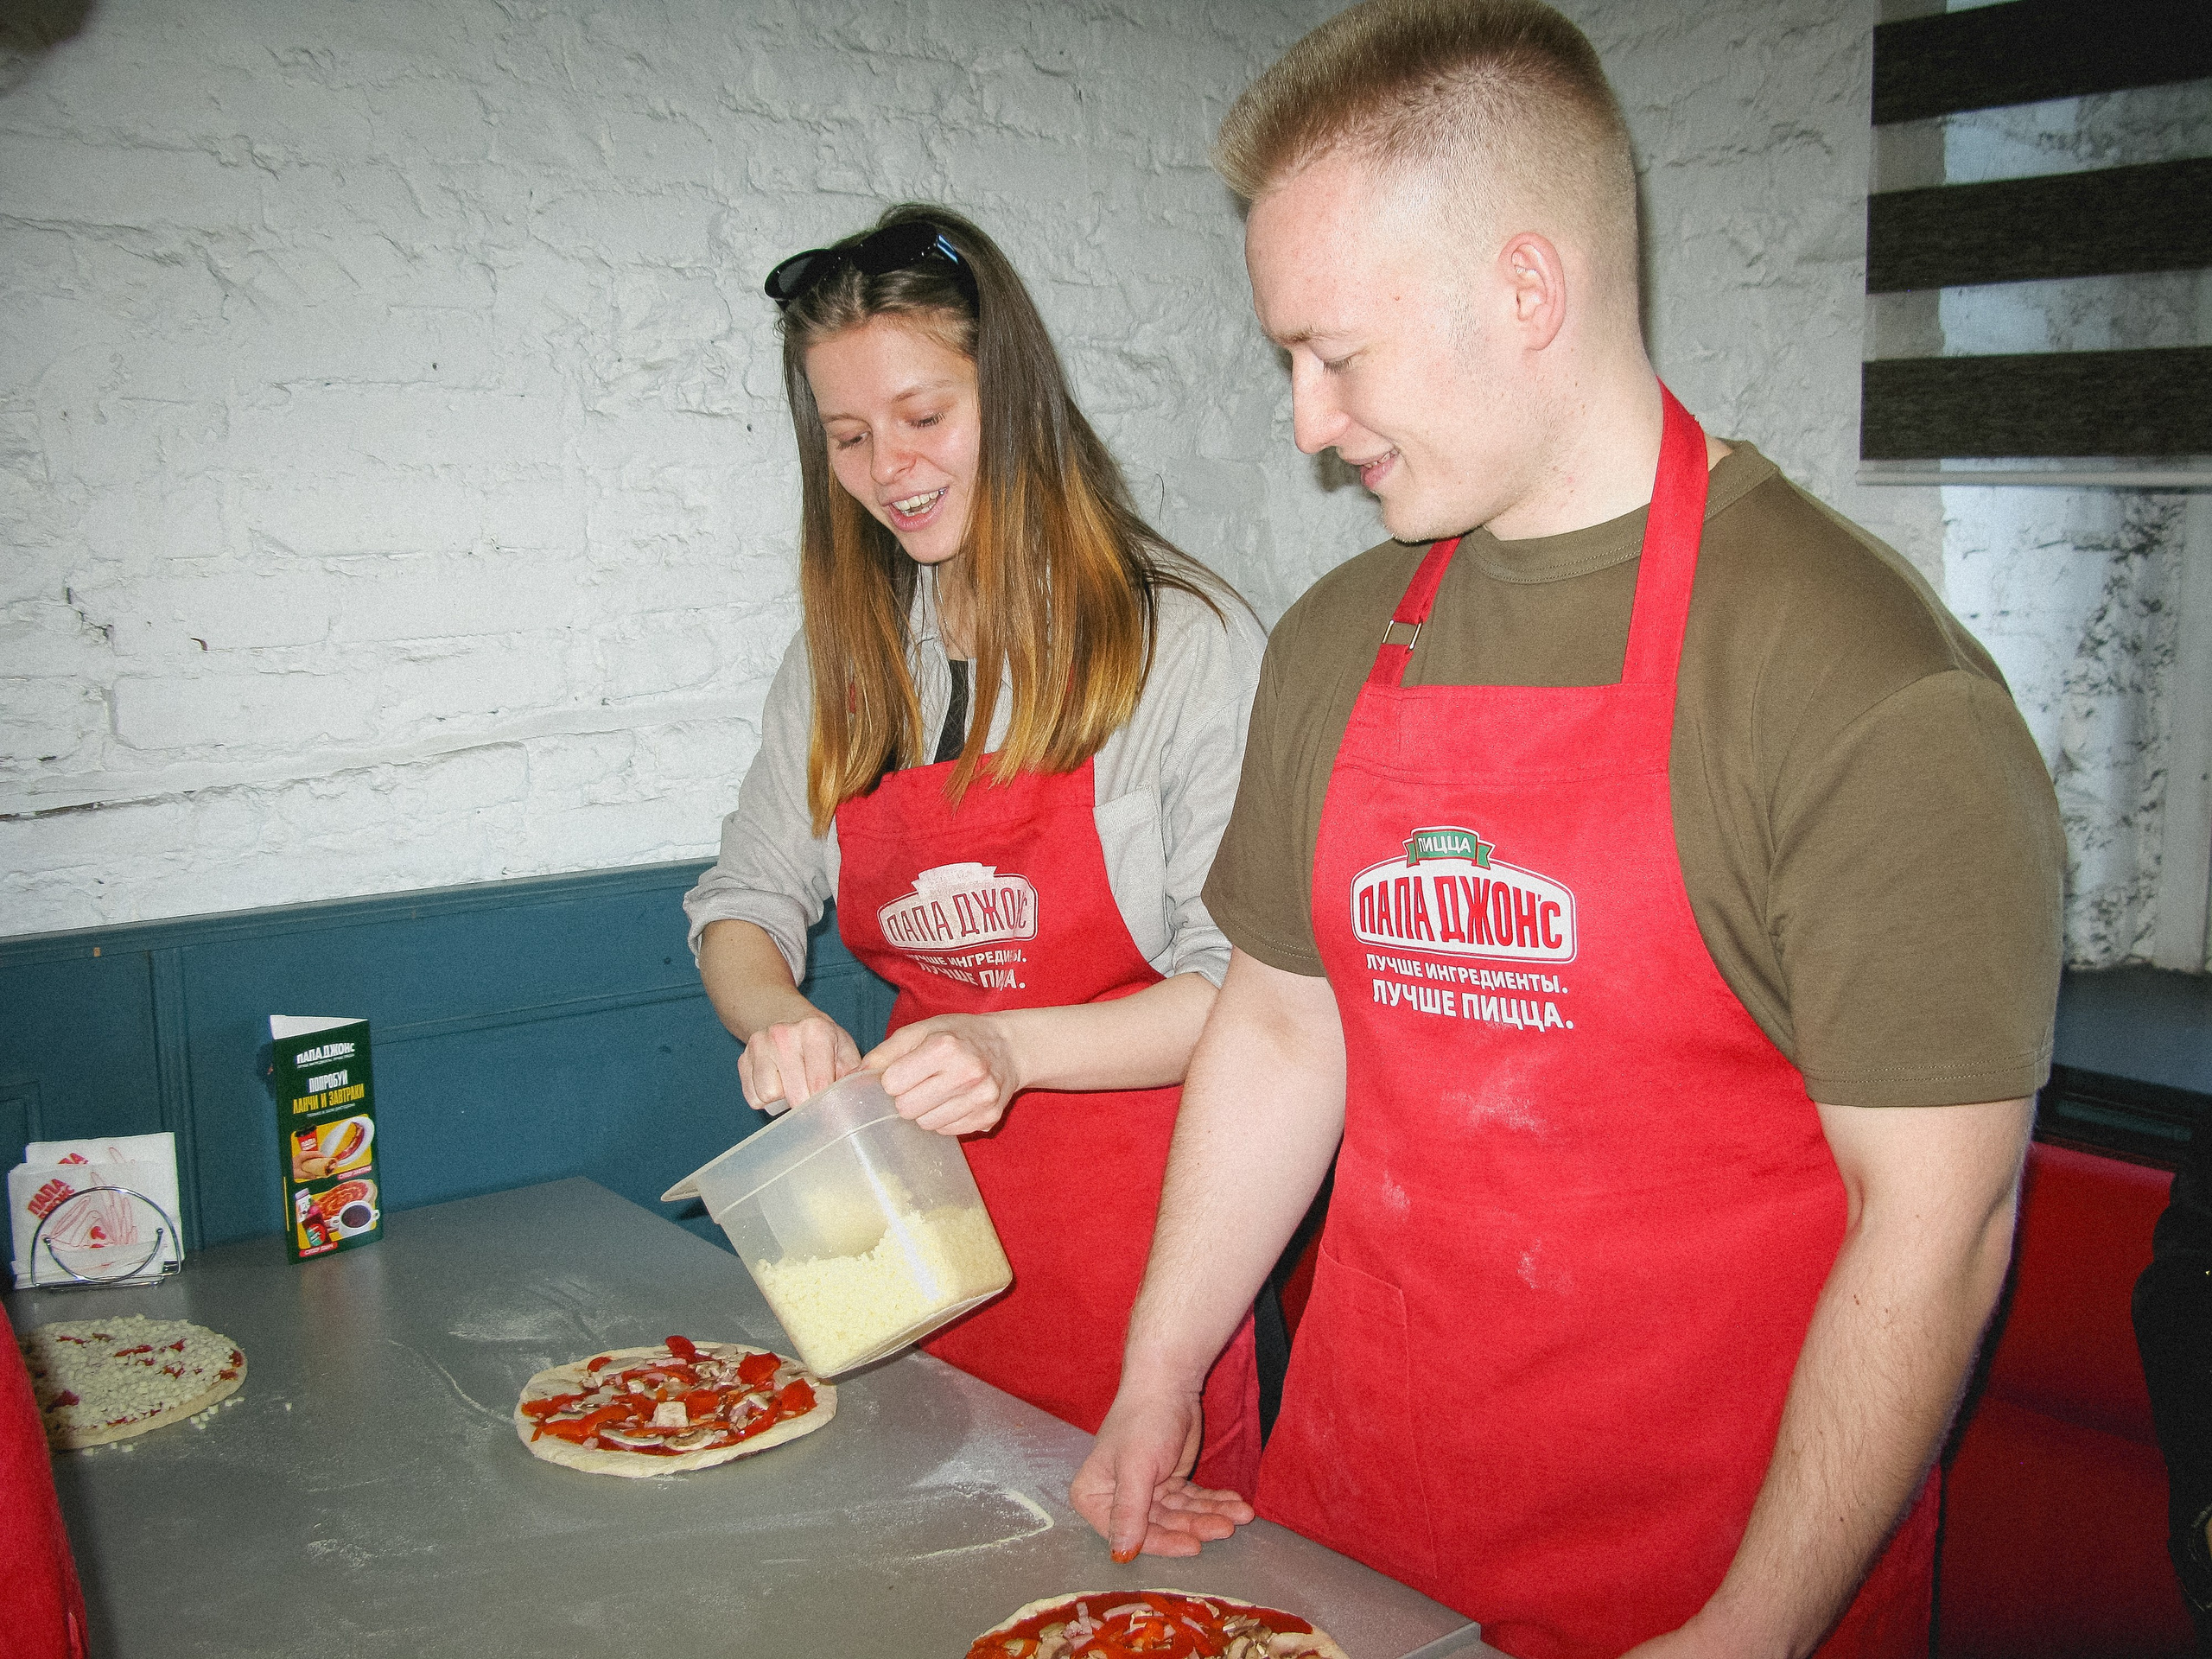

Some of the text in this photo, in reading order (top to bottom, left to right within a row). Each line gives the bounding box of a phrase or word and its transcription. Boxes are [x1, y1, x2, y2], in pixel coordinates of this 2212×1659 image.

[1416, 835, 1471, 854] ПИЦЦА
[887, 887, 1027, 942] ПАПА ДЖОС
[1359, 875, 1435, 942] ПАПА
[1365, 953, 1568, 994] ЛУЧШЕ ИНГРЕДИЕНТЫ.
[1372, 979, 1573, 1032] ЛУЧШЕ ПИЦЦА.
[296, 1046, 323, 1065] ПАПА
[322, 1042, 355, 1058] ДЖОНС
[293, 1095, 319, 1115] ЛАНЧИ
[321, 1092, 327, 1108] И
[328, 1083, 365, 1106] ЗАВТРАКИ
[308, 1069, 348, 1093] ПОПРОБУЙ
[28, 1179, 68, 1216] ПАПА
